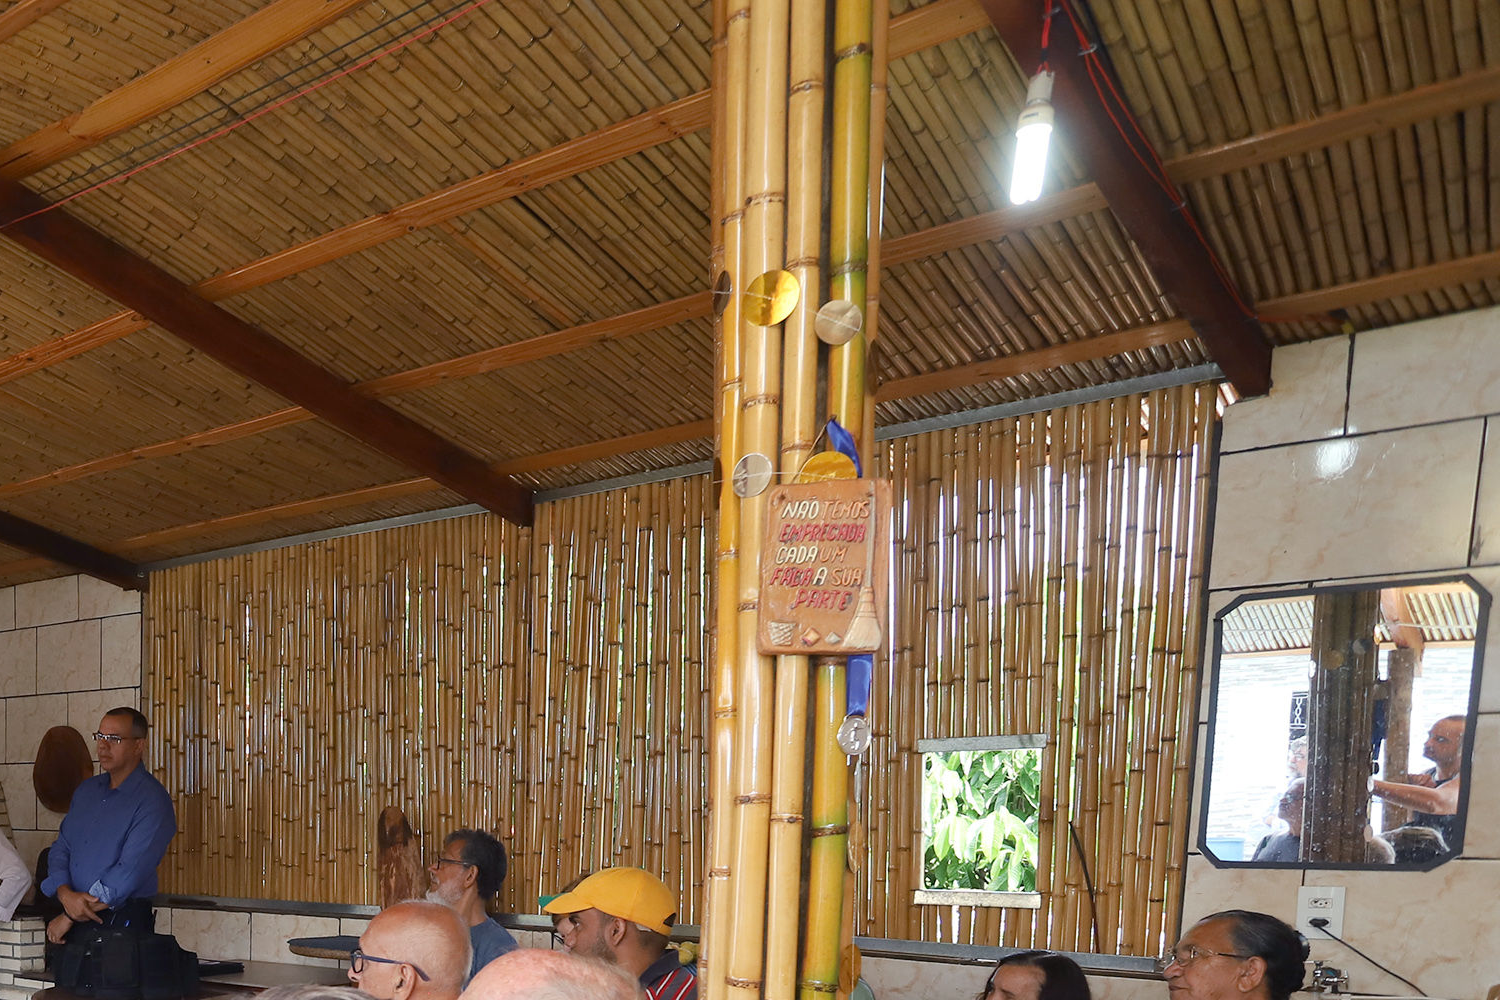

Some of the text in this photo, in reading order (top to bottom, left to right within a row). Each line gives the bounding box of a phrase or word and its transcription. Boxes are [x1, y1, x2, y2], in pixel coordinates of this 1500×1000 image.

[781, 496, 870, 520] NÃO TEMOS
[775, 545, 847, 565] CADA UM
[813, 567, 828, 585] A
[831, 567, 862, 587] SUA
[792, 588, 853, 611] PARTE
